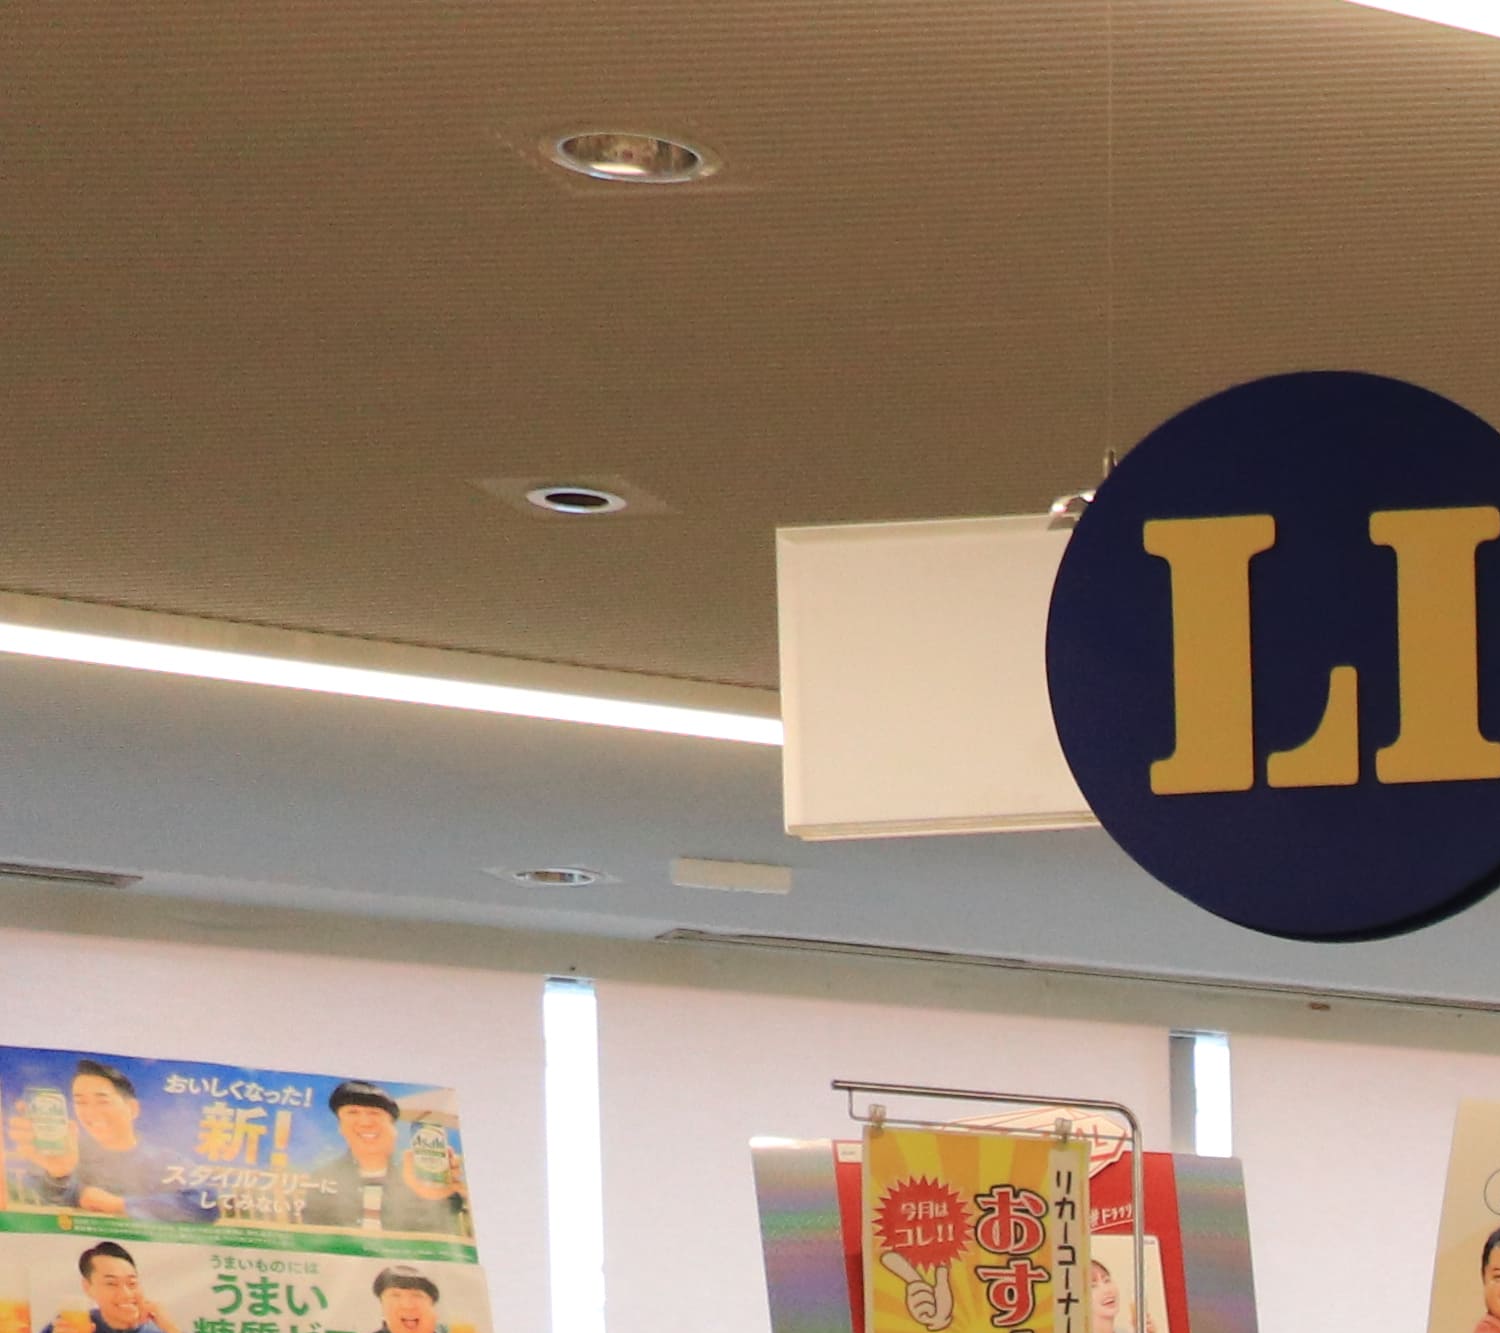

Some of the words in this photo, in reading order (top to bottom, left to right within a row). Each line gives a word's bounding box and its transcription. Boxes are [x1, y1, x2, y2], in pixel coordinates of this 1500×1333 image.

[195, 1102, 291, 1166] 新!
[162, 1165, 337, 1195] スタイルフリーに
[900, 1200, 949, 1222] 今月は
[210, 1273, 328, 1315] うまい
